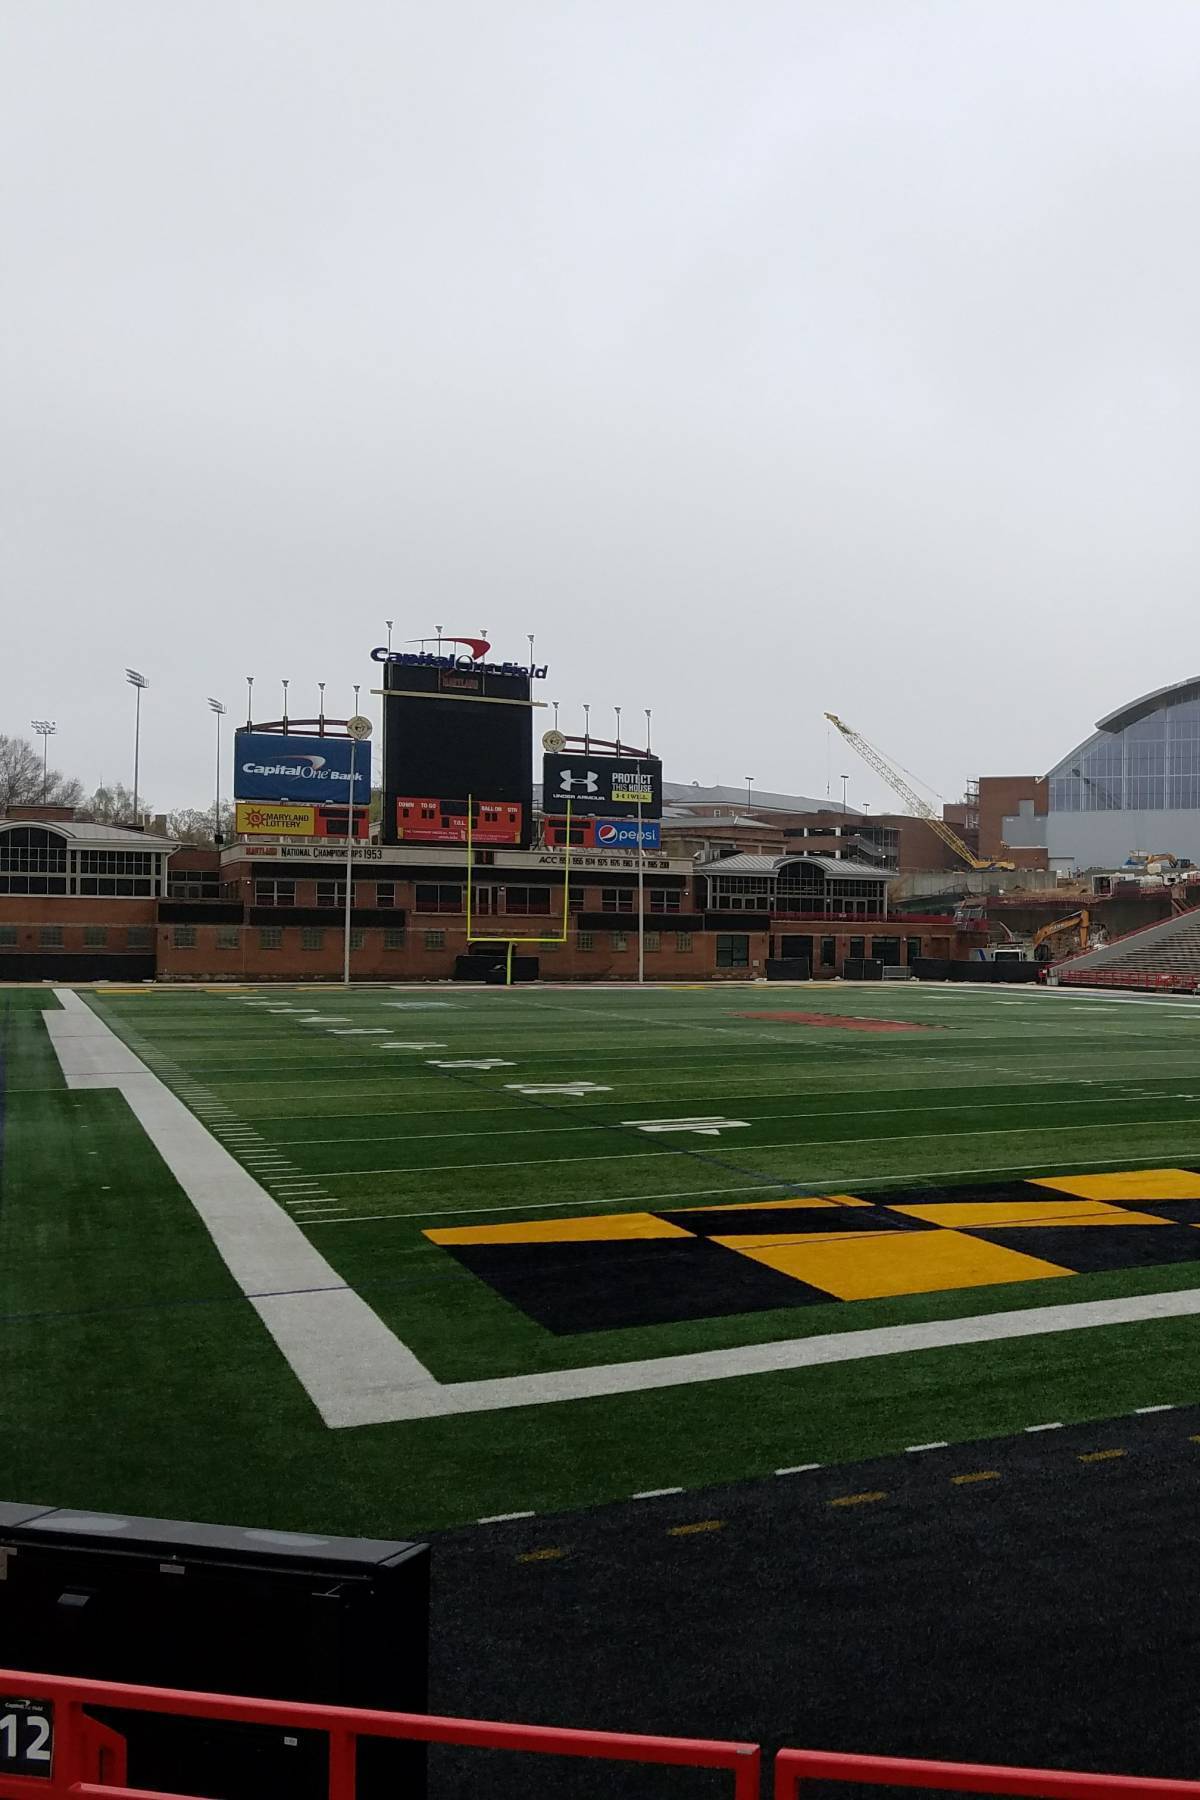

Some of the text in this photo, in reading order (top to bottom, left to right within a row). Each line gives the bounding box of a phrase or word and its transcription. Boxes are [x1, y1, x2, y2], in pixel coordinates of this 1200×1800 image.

[331, 771, 364, 781] Bank
[612, 783, 628, 791] THIS
[266, 813, 309, 822] MARYLAND
[266, 820, 301, 828] LOTTERY
[619, 830, 655, 842] pepsi
[281, 847, 311, 857] NATIONAL
[313, 847, 363, 859] CHAMPIONSIPS
[363, 849, 382, 860] 1953
[539, 856, 557, 864] ACC
[0, 1714, 51, 1760] 12
